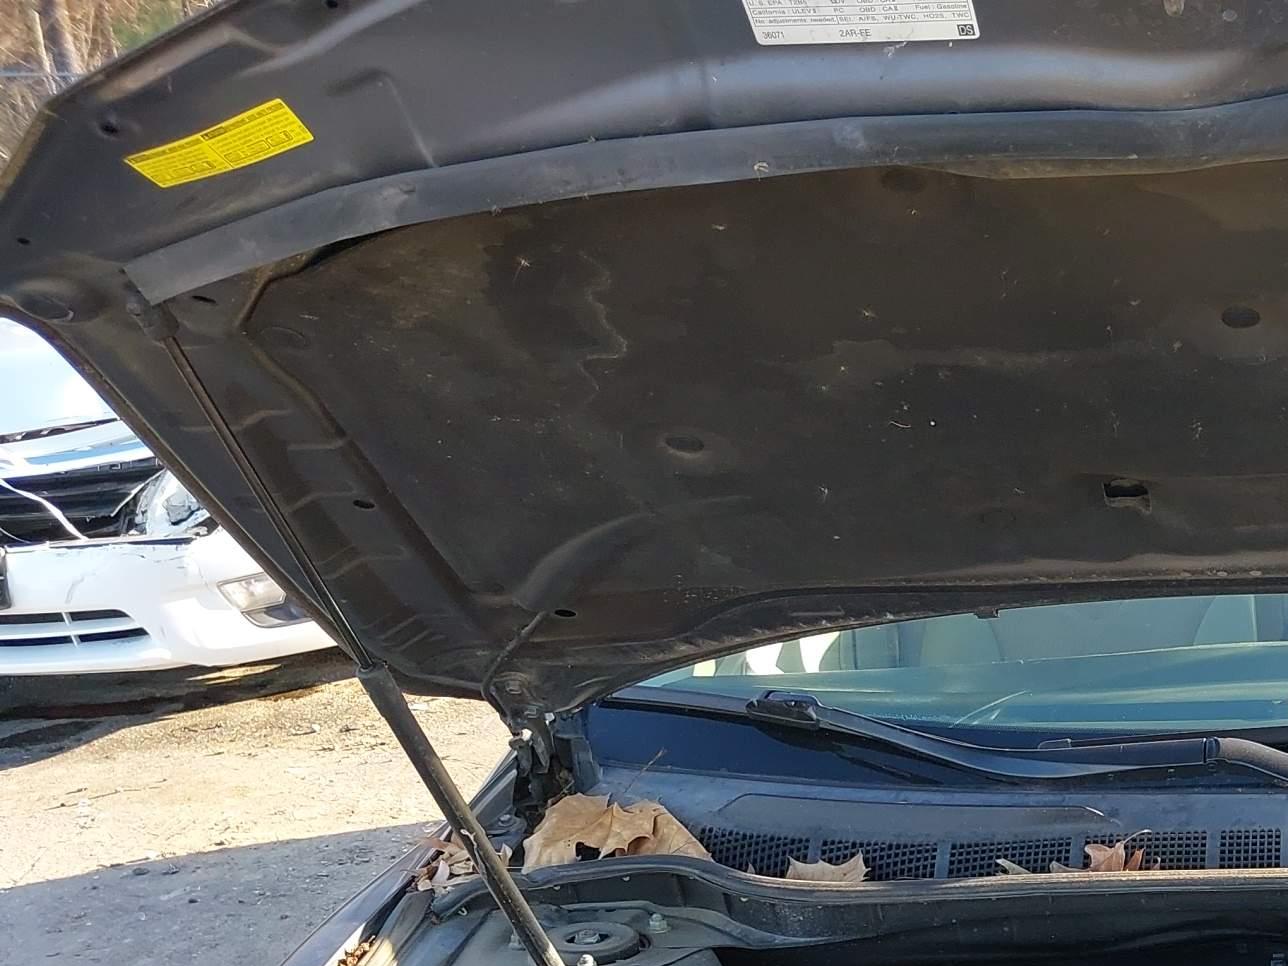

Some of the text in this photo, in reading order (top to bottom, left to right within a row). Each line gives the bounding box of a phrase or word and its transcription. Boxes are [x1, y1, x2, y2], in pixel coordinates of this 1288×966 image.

[839, 28, 871, 38] 2AR-FE
[958, 24, 975, 36] DS
[762, 31, 785, 40] 36071
